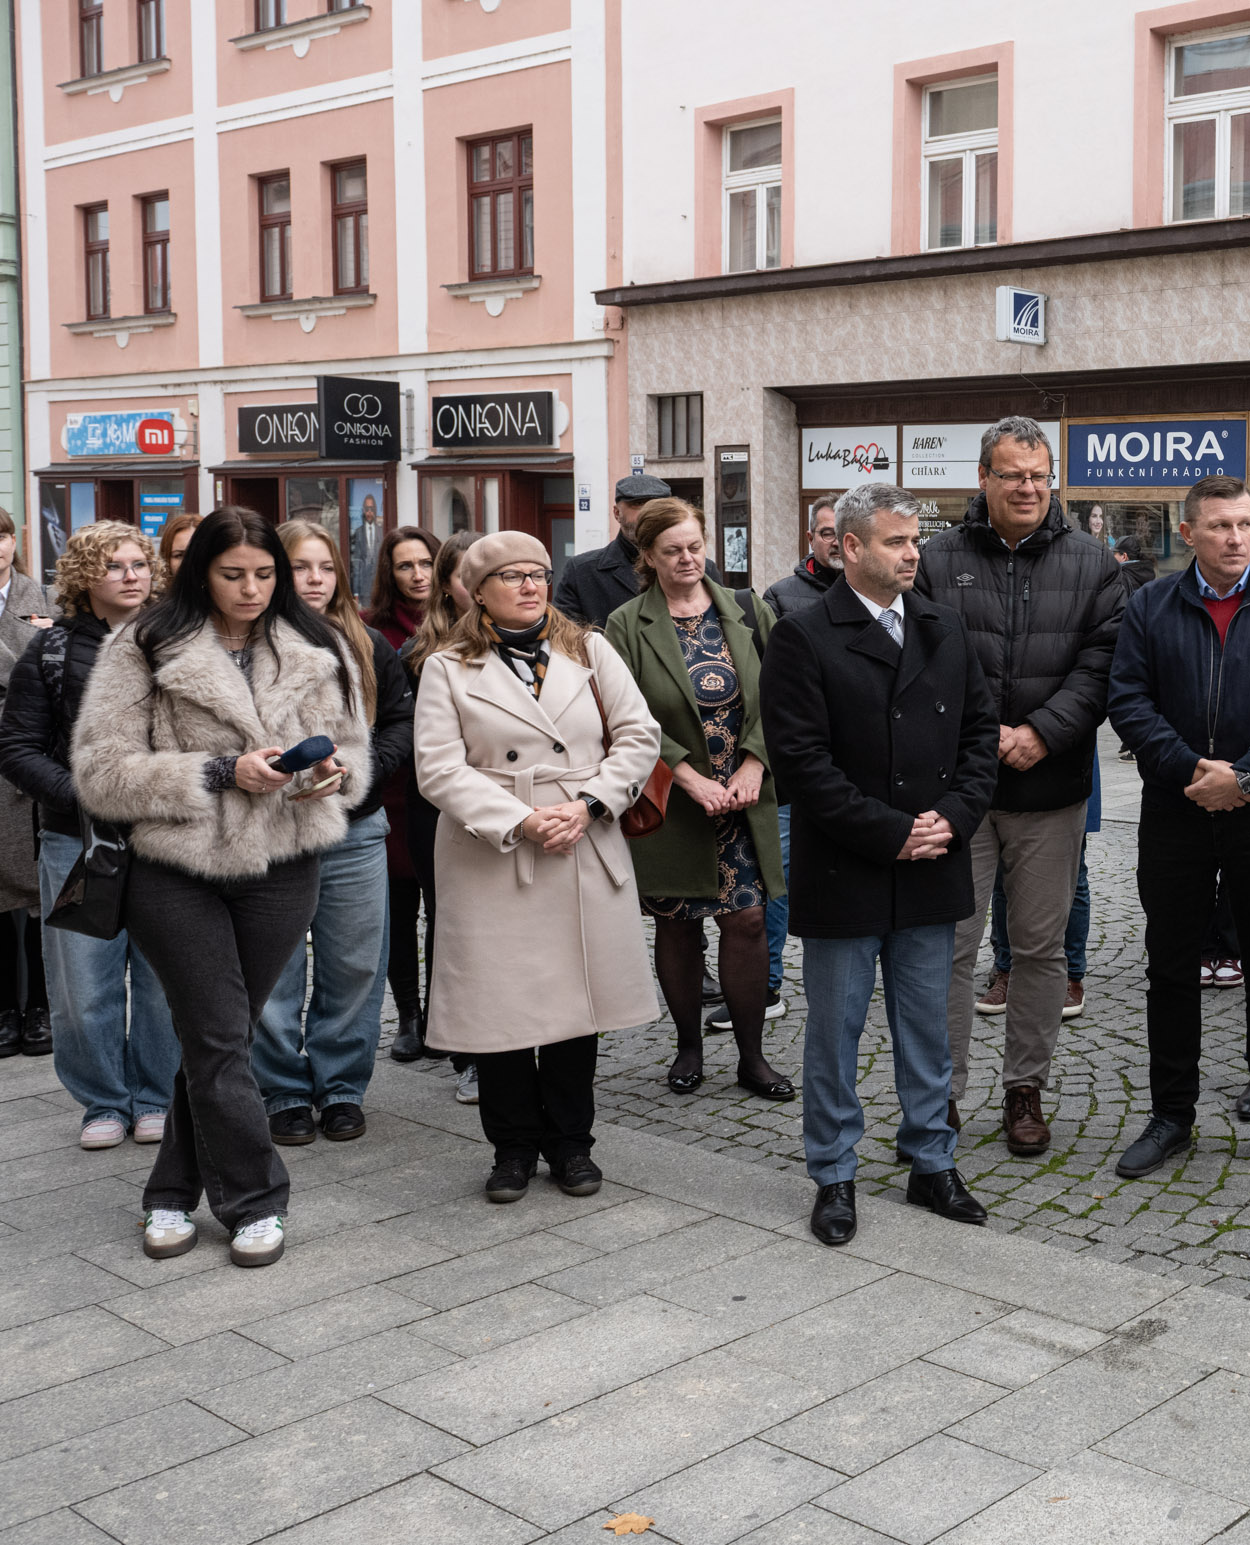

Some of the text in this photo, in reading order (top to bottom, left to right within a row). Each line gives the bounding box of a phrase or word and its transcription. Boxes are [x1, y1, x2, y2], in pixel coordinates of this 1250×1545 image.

[1013, 326, 1040, 336] MOIRA
[343, 437, 383, 446] FASHION
[1087, 466, 1154, 478] FUNKČNÍ
[580, 501, 588, 510] 32
